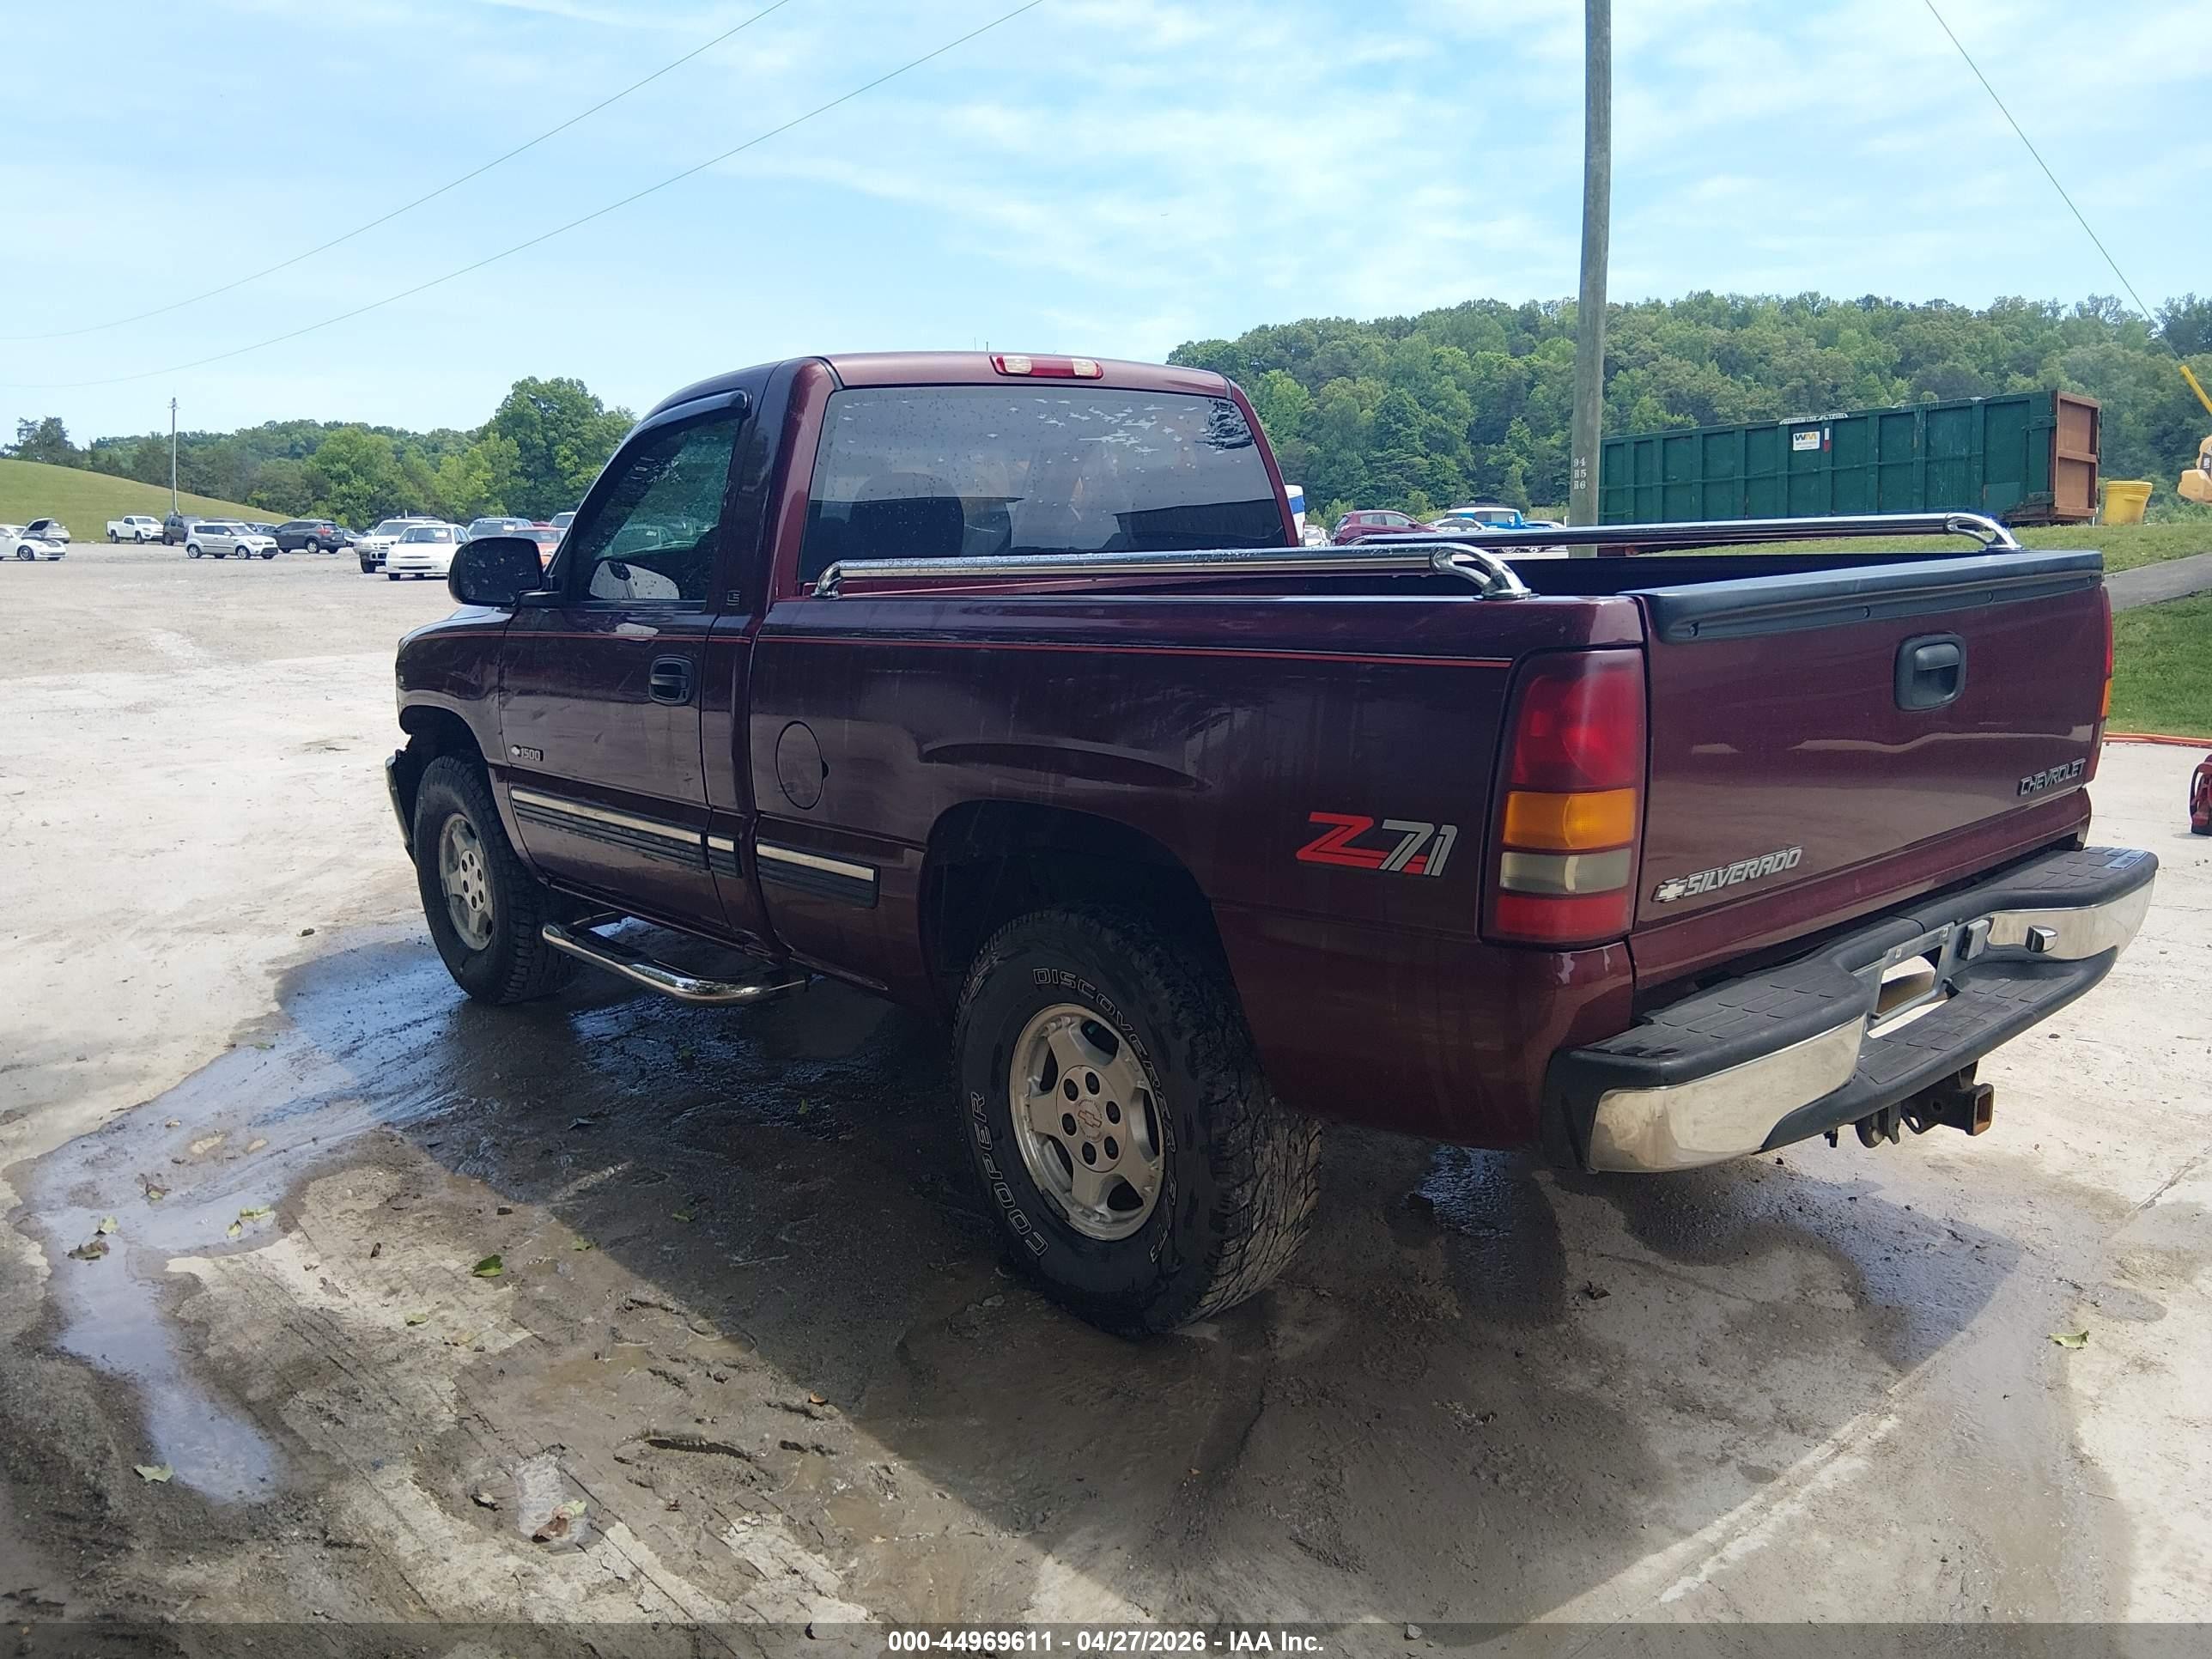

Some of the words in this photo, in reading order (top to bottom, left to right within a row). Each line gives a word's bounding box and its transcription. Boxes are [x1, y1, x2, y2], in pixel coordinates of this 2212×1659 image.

[1795, 433, 1817, 441] WM
[520, 748, 542, 762] 1500
[2019, 757, 2087, 795] CHEVROLET
[1296, 811, 1458, 877] Z71
[1684, 846, 1803, 896] SILVERADO
[1031, 967, 1177, 1154] DISCOVERER
[969, 1091, 1050, 1258] COOPER
